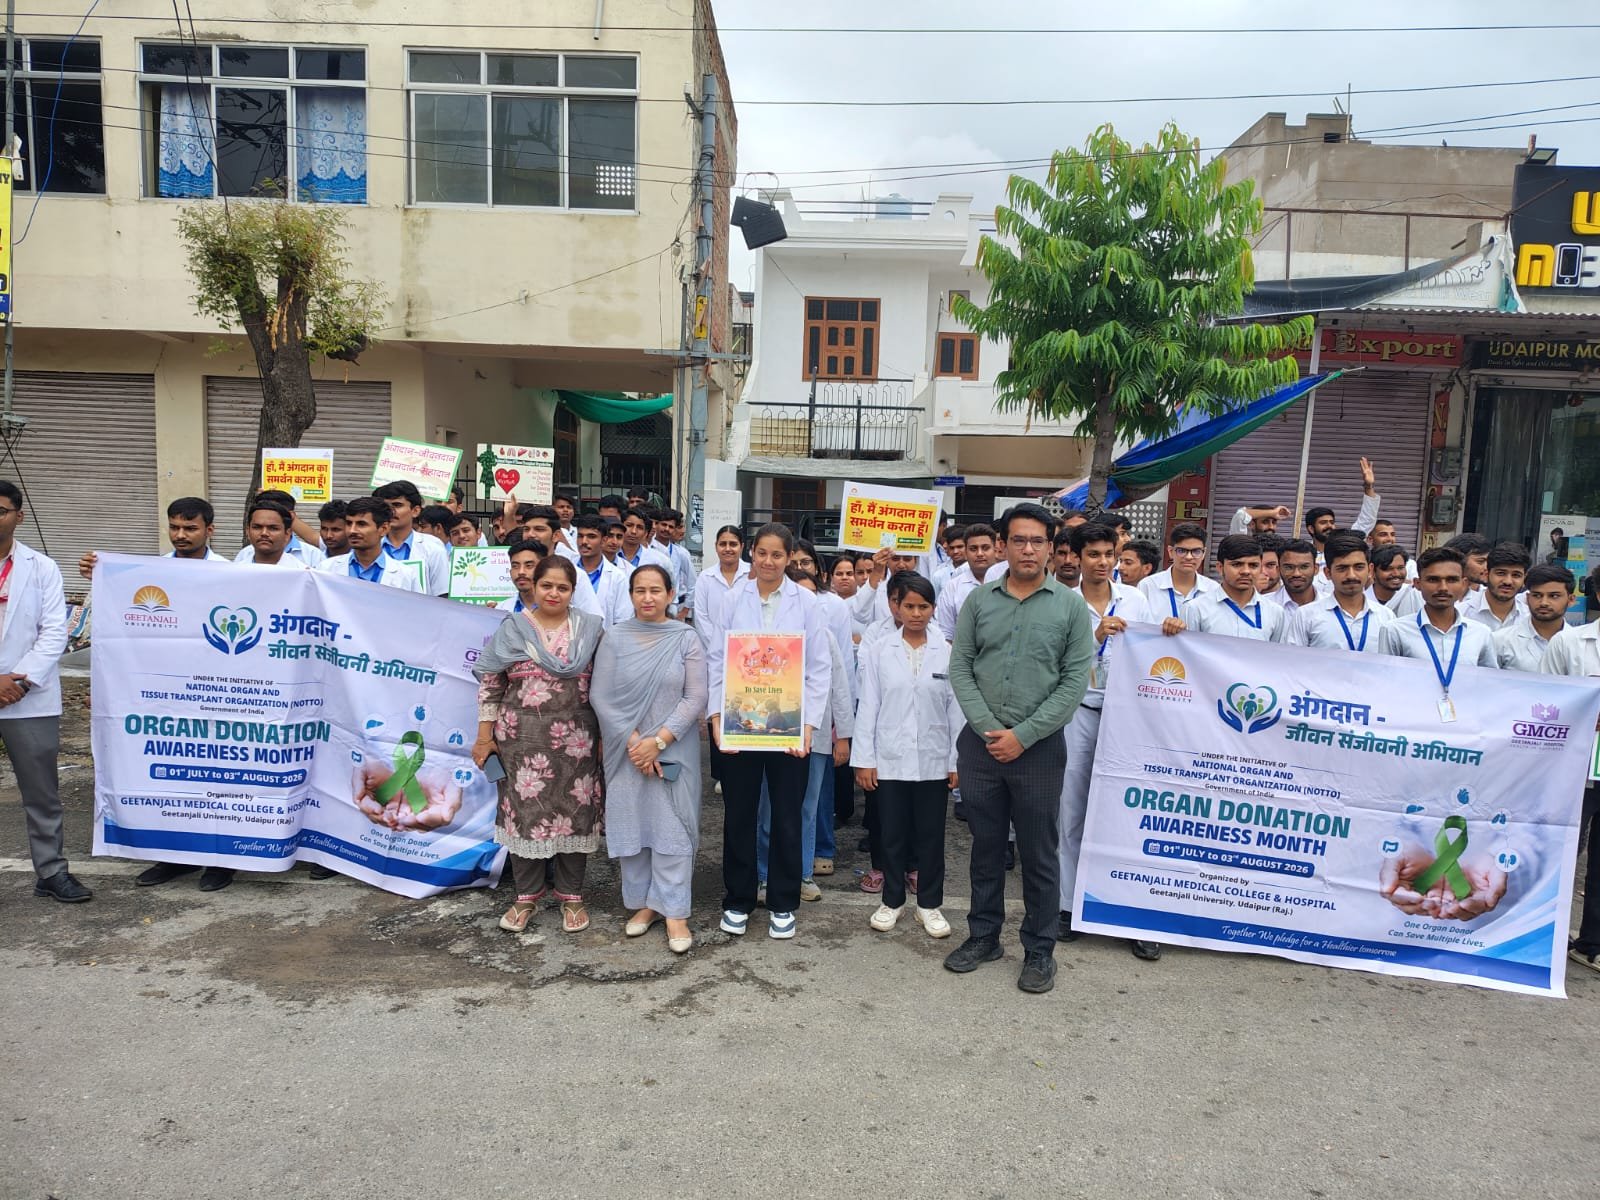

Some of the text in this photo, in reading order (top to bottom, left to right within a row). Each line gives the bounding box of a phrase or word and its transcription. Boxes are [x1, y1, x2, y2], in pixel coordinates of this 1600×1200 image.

[1334, 331, 1457, 362] Export
[1489, 341, 1569, 358] UDAIPUR
[287, 461, 314, 472] अंगदान
[317, 464, 328, 472] का
[266, 473, 292, 484] समर्थन
[294, 476, 316, 484] करता
[850, 501, 933, 520] हाँ, मैं अंगदान का
[850, 516, 885, 529] समर्थन
[887, 522, 916, 532] करता
[124, 613, 178, 624] GEETANJALI
[268, 608, 340, 642] अंगदान
[268, 639, 438, 686] जीवन संजीवनी अभियान
[186, 683, 280, 697] NATIONAL ORGAN AND
[229, 677, 264, 685] INITIATIVE
[745, 686, 783, 694] To Save Lives
[141, 691, 324, 709] TISSUE TRANSPLANT ORGANIZATION (NOTTO)
[1137, 693, 1192, 704] UNIVERSITY
[1138, 684, 1192, 698] GEETANJALI
[200, 705, 239, 713] Government
[1289, 690, 1371, 726] अंगदान
[124, 714, 331, 744] ORGAN DONATION
[1513, 723, 1570, 739] GMCH
[144, 740, 314, 764] AWARENESS MONTH
[1285, 723, 1483, 766] जीवन संजीवनी अभियान
[1201, 752, 1224, 761] UNDER
[1239, 756, 1277, 768] INITIATIVE
[187, 769, 210, 779] JULY
[212, 770, 222, 779] to
[242, 773, 280, 784] AUGUST
[282, 773, 303, 784] 2026
[1192, 760, 1294, 780] NATIONAL ORGAN AND
[1144, 764, 1341, 800] TISSUE TRANSPLANT ORGANIZATION (NOTTO)
[1205, 783, 1248, 795] Government
[1256, 790, 1275, 799] India
[206, 791, 254, 801] Organized by
[120, 797, 181, 808] GEETANJALI
[184, 799, 229, 811] MEDICAL
[232, 802, 274, 814] COLLEGE
[276, 806, 284, 815] &
[1124, 786, 1351, 839] ORGAN DONATION
[161, 810, 201, 820] Geetanjali
[203, 812, 243, 823] University,
[245, 815, 275, 825] Udaipur
[370, 828, 432, 848] One Organ Donor
[1139, 814, 1327, 856] AWARENESS MONTH
[232, 840, 266, 856] Together
[266, 843, 282, 853] We
[307, 834, 338, 850] Healthier
[339, 844, 369, 862] tomorrow
[359, 834, 441, 860] Can Save Multiple Lives.
[1181, 848, 1204, 859] JULY
[1207, 850, 1219, 860] to
[1240, 856, 1282, 870] AUGUST
[1284, 863, 1309, 874] 2026
[1199, 871, 1250, 886] Organized by
[1110, 870, 1337, 911] GEETANJALI MEDICAL COLLEGE & HOSPITAL
[1149, 888, 1294, 916] Geetanjali University, Udaipur (Raj.)
[1404, 920, 1475, 936] One Organ Donor
[1221, 925, 1257, 941] Together
[1257, 930, 1274, 941] We
[1273, 933, 1301, 949] pledge
[1300, 936, 1313, 951] for
[1321, 939, 1357, 953] Healthier
[1358, 945, 1397, 957] tomorrow
[1388, 929, 1486, 948] Can Save Multiple Lives.
